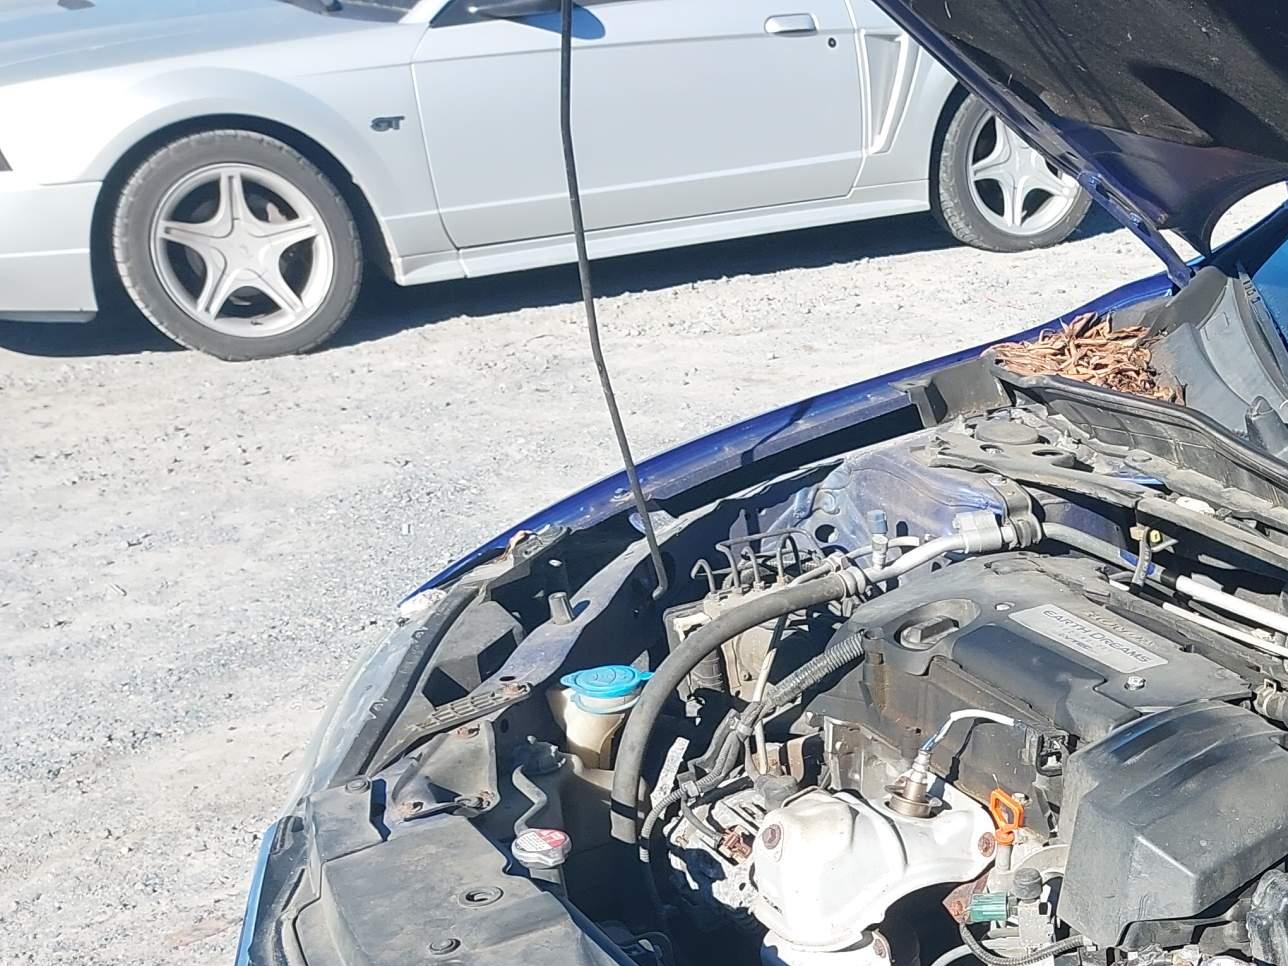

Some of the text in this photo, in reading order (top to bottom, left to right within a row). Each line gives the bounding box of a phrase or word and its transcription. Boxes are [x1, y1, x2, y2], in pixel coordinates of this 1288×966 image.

[370, 116, 405, 132] GT
[1043, 610, 1090, 634] EARTH
[1090, 631, 1151, 663] DREAMS
